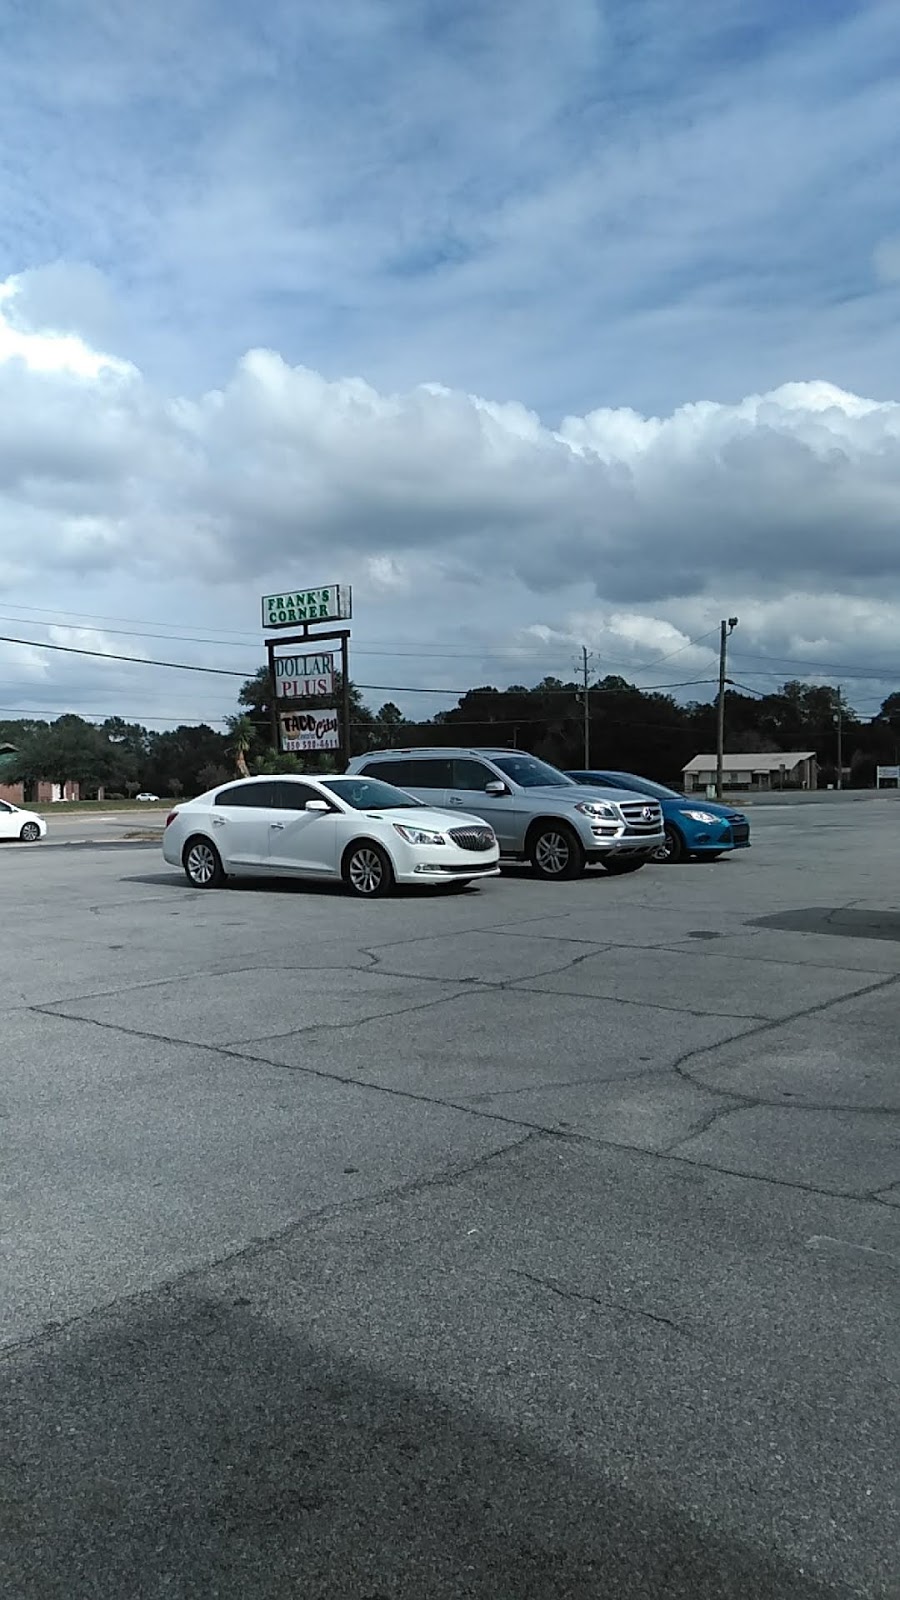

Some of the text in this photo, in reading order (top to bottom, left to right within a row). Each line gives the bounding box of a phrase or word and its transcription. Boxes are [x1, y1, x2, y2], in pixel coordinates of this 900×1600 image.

[268, 590, 330, 610] FRANK'S
[269, 604, 329, 623] CORNER
[276, 656, 331, 677] DOLLAR
[282, 679, 327, 696] PLUS
[282, 714, 316, 732] TACO
